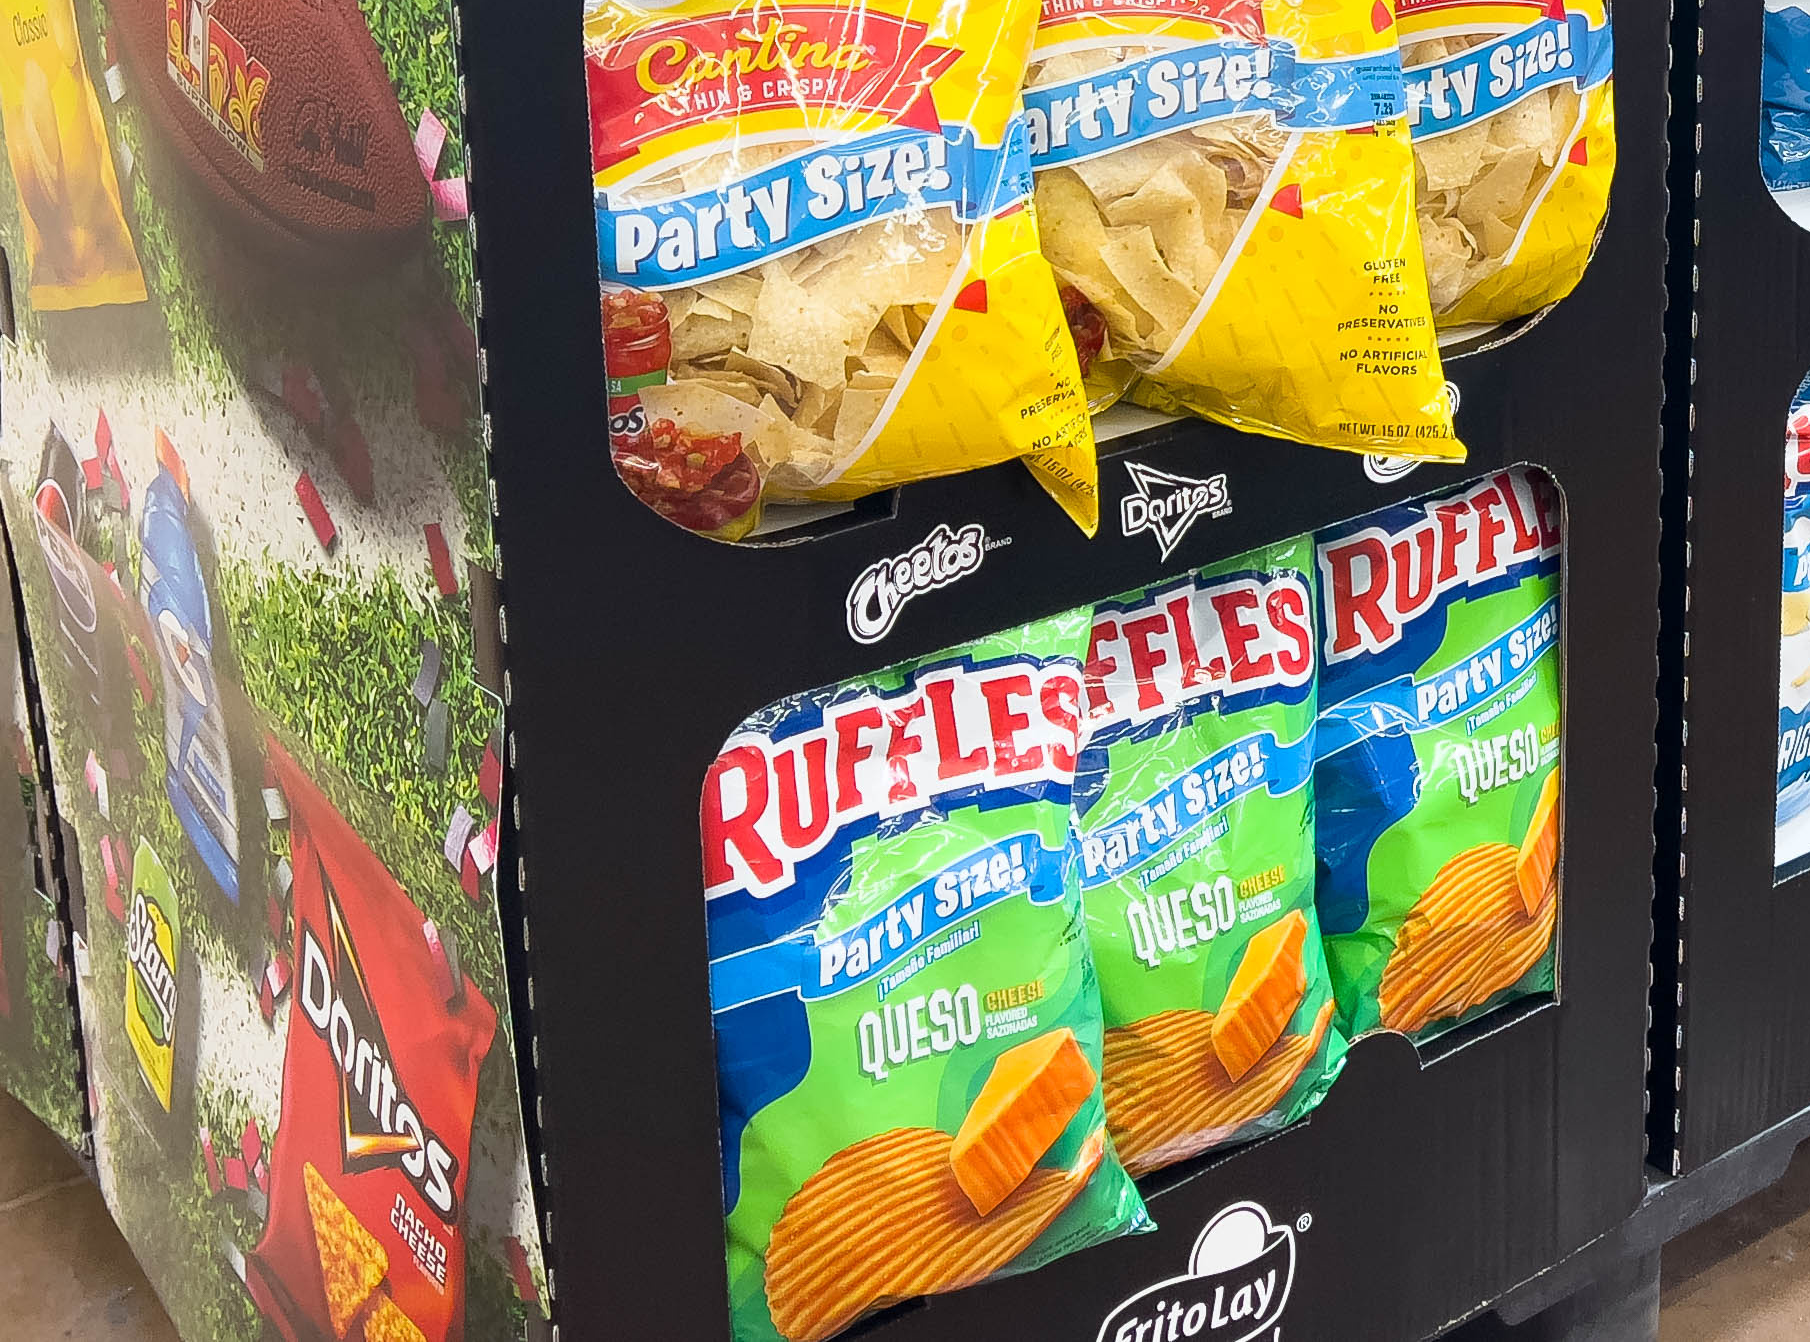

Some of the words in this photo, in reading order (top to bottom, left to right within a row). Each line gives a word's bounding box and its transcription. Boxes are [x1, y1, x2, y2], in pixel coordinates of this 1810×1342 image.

[12, 8, 48, 47] Classic
[637, 19, 870, 95] Cantina
[1490, 22, 1573, 96] Size!
[763, 78, 838, 100] CRISPY
[1162, 47, 1273, 111] Size!
[615, 175, 791, 274] Party
[801, 138, 948, 220] Size!
[1364, 258, 1406, 271] GLUTEN
[1373, 273, 1400, 284] FREE
[1337, 316, 1426, 332] PRESERVATIVES
[1379, 304, 1398, 315] NO
[1340, 349, 1358, 361] NO
[1362, 349, 1428, 361] ARTIFICIAL
[1356, 363, 1417, 375] FLAVORS
[1127, 478, 1226, 533] Doritos
[850, 528, 981, 641] Cheetos
[1417, 653, 1501, 724] Party
[1509, 605, 1559, 678] Size!
[704, 676, 1080, 886] RUFFLES
[1455, 723, 1538, 804] QUESO
[1083, 789, 1181, 877] Party
[1183, 741, 1266, 818] Size!
[820, 911, 925, 984] Party
[934, 841, 1029, 914] Size!
[1127, 875, 1236, 968] QUESO
[859, 983, 981, 1080] QUESO
[985, 981, 1044, 1012] CHEESE
[302, 929, 458, 1218] Doritos
[390, 1211, 447, 1285] CHEESE
[395, 1192, 448, 1262] NACHO
